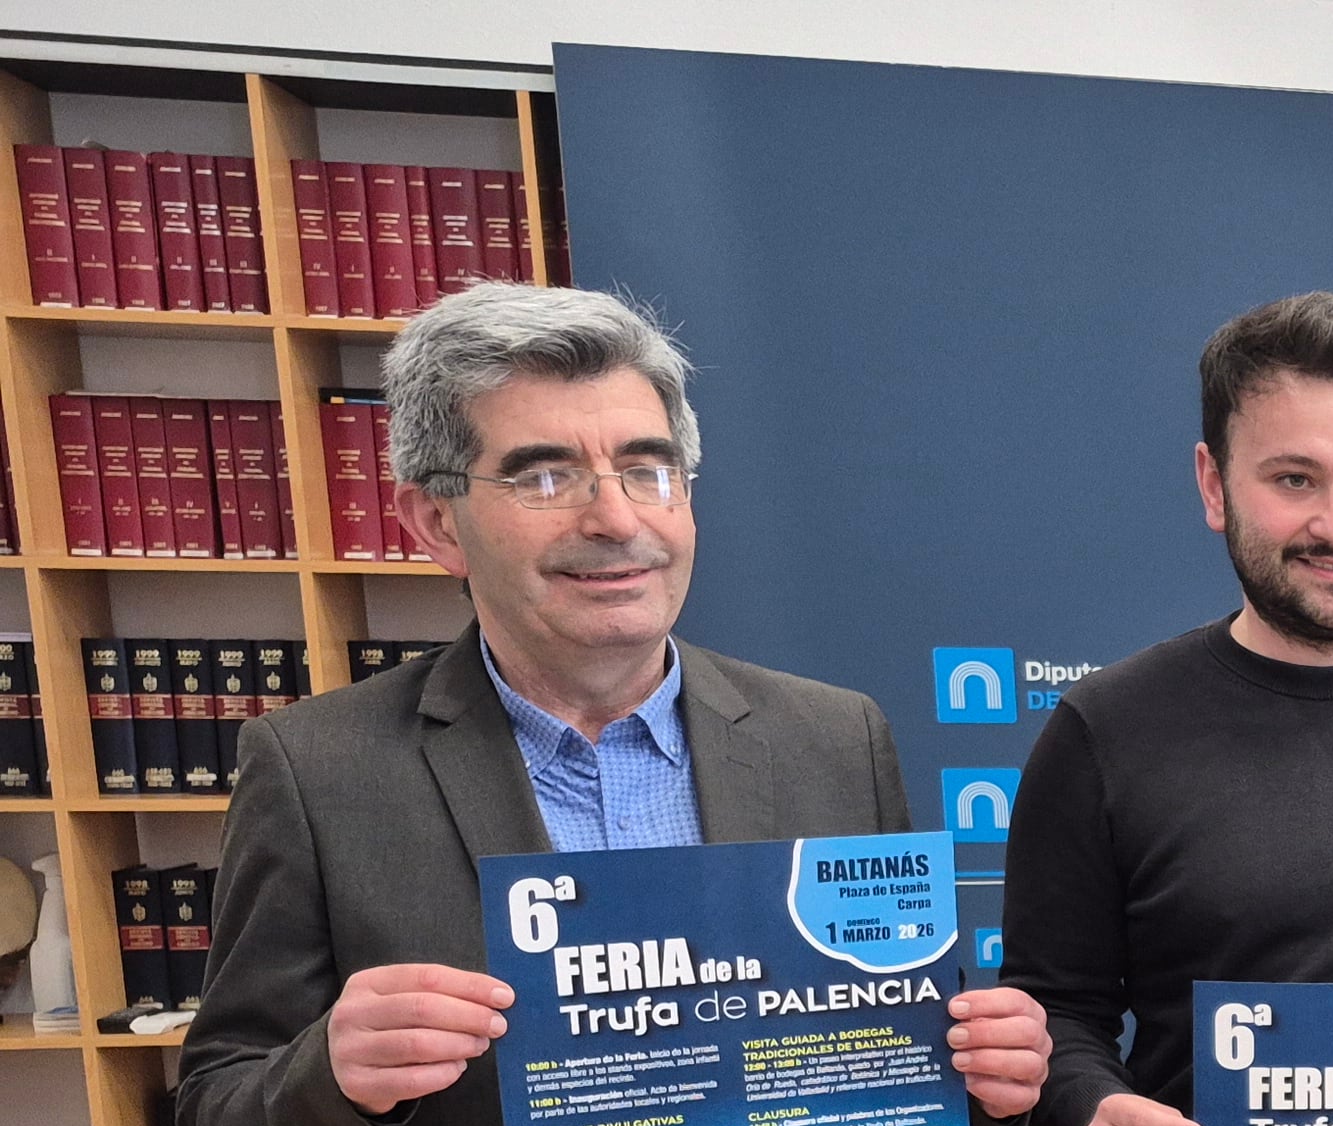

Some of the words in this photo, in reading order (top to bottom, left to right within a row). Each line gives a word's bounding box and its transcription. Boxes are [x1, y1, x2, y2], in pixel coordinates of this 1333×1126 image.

[1024, 661, 1104, 685] Diput
[816, 851, 929, 883] BALTANÁS
[839, 885, 870, 899] Plaza
[872, 884, 887, 896] de
[890, 882, 931, 896] España
[508, 875, 577, 953] 6ª
[897, 898, 931, 911] Carpa
[825, 921, 837, 944] 1
[843, 926, 890, 943] MARZO
[898, 922, 934, 940] 2026
[553, 937, 696, 997] FERIA
[700, 958, 732, 984] de
[736, 956, 762, 981] la
[559, 996, 680, 1036] Trufa
[694, 990, 747, 1022] de
[758, 976, 941, 1017] PALENCIA
[742, 1035, 778, 1050] VISITA
[781, 1031, 824, 1046] GUIADA
[828, 1031, 837, 1042] A
[839, 1026, 894, 1041] BODEGAS
[743, 1042, 834, 1062] TRADICIONALES
[837, 1041, 852, 1052] DE
[854, 1035, 912, 1051] BALTANÁS
[1215, 1002, 1272, 1070] 6ª
[748, 1107, 810, 1122] CLAUSURA
